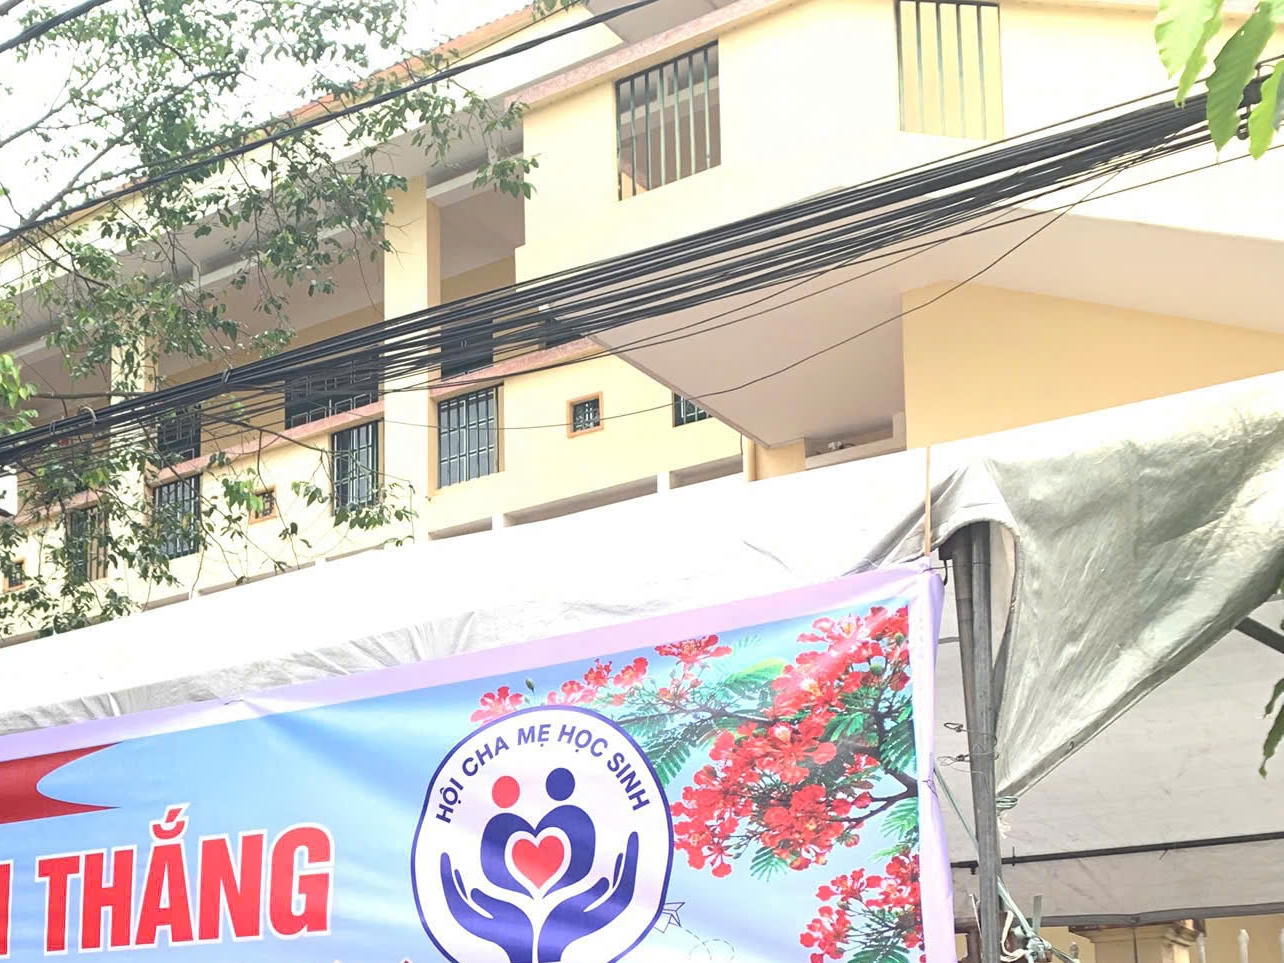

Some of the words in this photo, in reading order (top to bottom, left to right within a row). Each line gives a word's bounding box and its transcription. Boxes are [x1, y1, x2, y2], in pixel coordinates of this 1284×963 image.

[435, 777, 464, 824] HỘI
[461, 735, 510, 778] CHA
[516, 723, 552, 748] MẸ
[557, 723, 609, 758] HỌC
[606, 751, 651, 812] SINH
[37, 806, 332, 954] THẮNG
